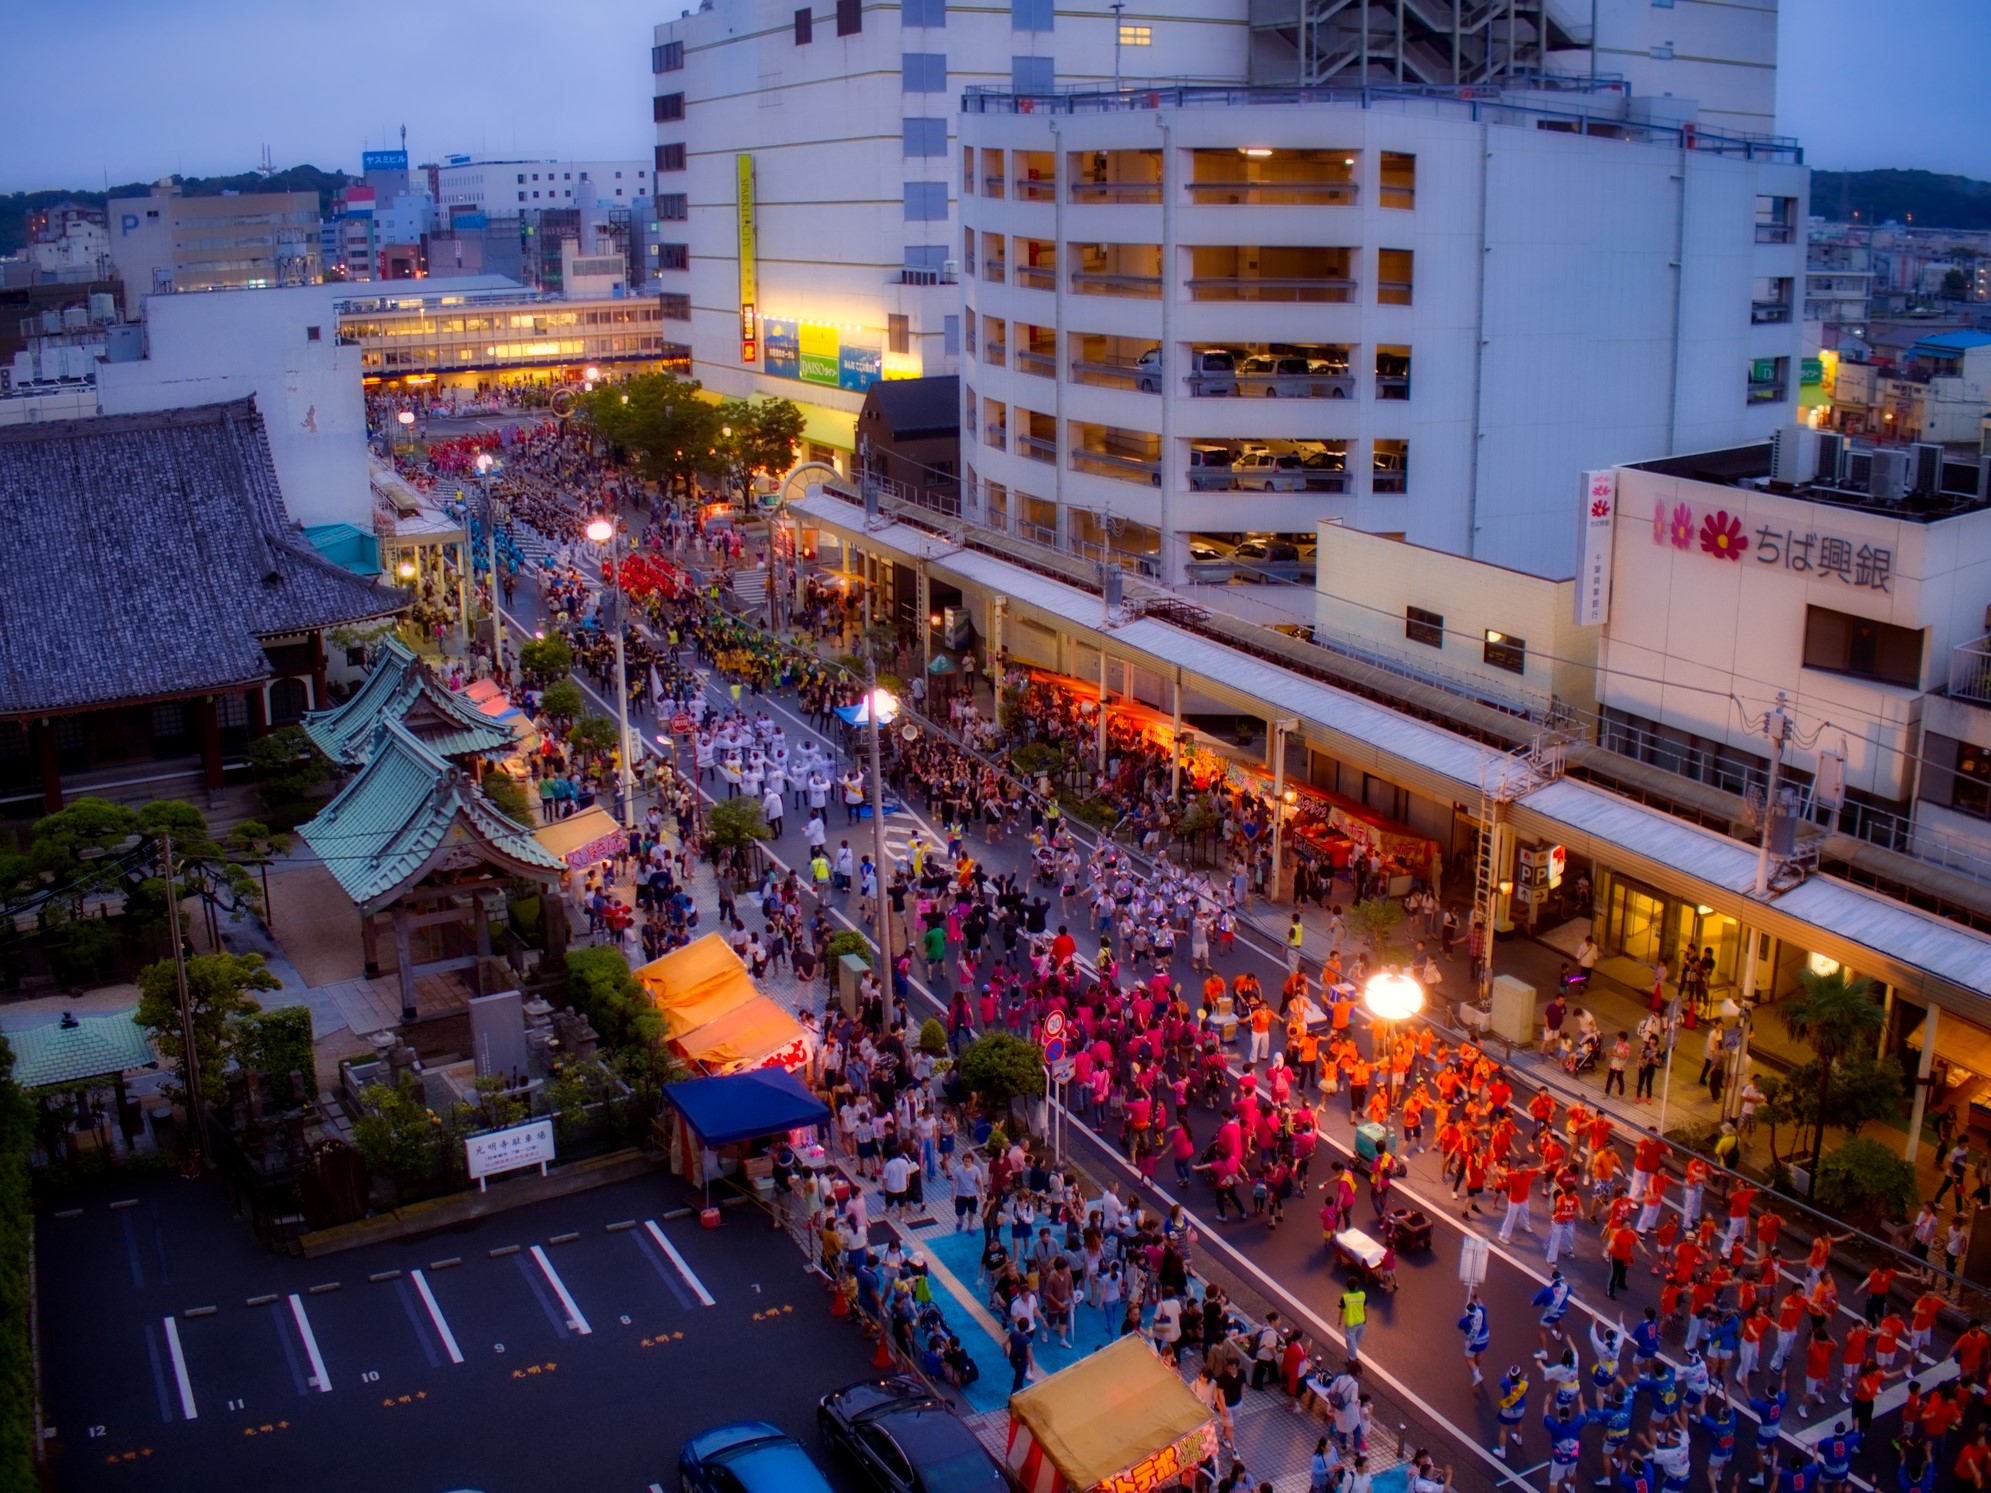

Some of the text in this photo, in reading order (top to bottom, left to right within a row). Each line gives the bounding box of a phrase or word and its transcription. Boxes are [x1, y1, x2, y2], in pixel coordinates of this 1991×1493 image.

[366, 155, 406, 165] ヤスミビル
[741, 178, 751, 248] SPARKLE CITY
[121, 214, 140, 237] P
[802, 360, 824, 379] DAISO
[1590, 520, 1611, 528] ちば興銀
[1756, 524, 1891, 594] ちば興銀
[1592, 553, 1602, 620] 千葉興業銀行
[1521, 864, 1532, 882] P
[1536, 867, 1548, 885] P
[1049, 1017, 1062, 1032] 30
[475, 1130, 546, 1156] 光明寺駐車場
[751, 1283, 762, 1294] 7
[620, 1314, 632, 1325] 8
[494, 1343, 506, 1354] 9
[361, 1370, 380, 1383] 10
[228, 1398, 245, 1411] 11
[88, 1425, 107, 1438] 12
